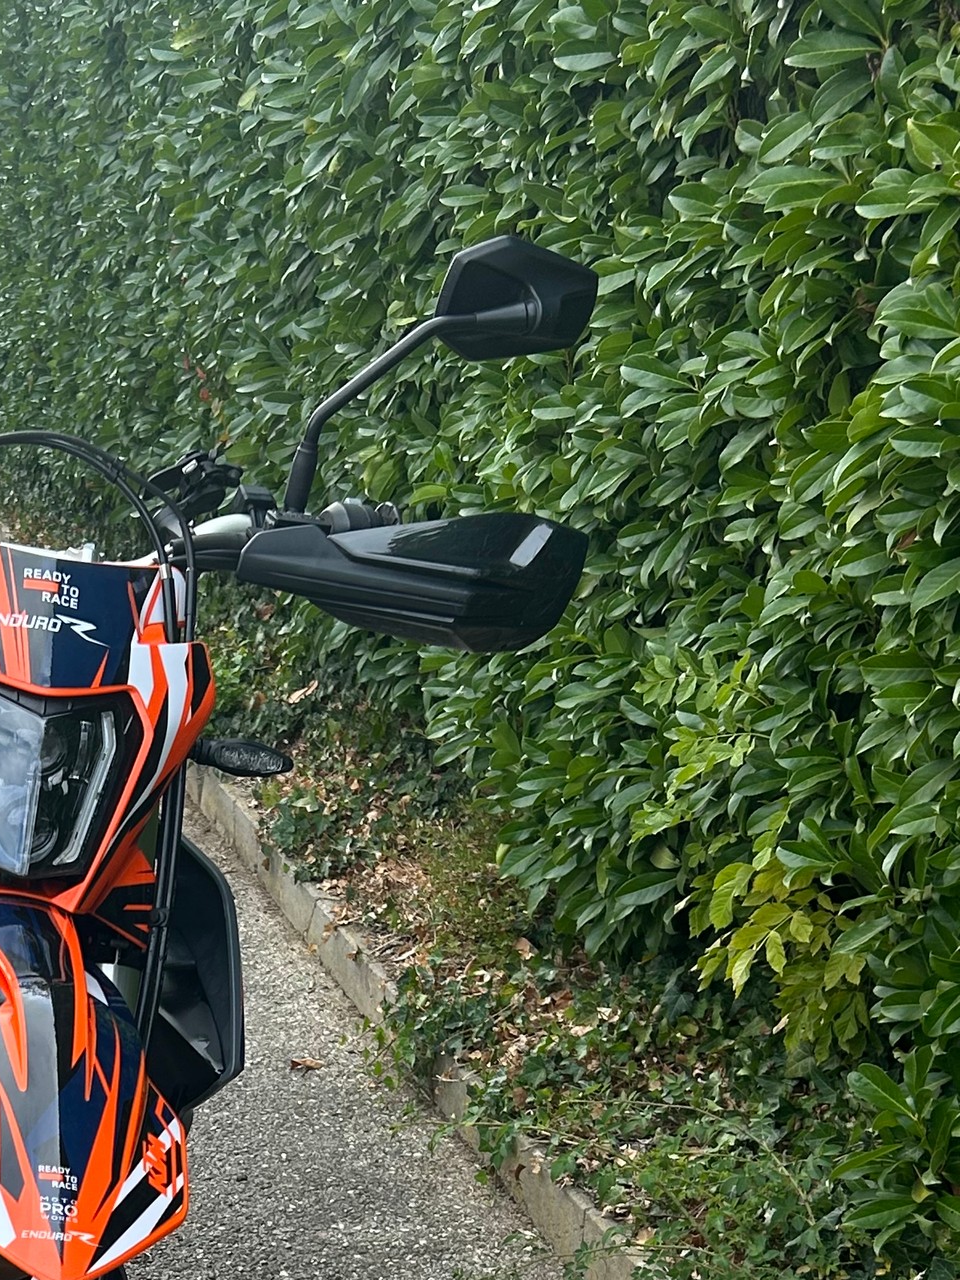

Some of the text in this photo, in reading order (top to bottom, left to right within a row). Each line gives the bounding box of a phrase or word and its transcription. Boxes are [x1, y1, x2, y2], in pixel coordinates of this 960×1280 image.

[23, 567, 71, 584] READY
[61, 584, 80, 598] TO
[41, 591, 79, 610] RACE
[37, 1164, 71, 1175] READY
[142, 1132, 168, 1197] KTM
[51, 1180, 78, 1191] RACE
[64, 1174, 78, 1184] TO
[40, 1195, 78, 1205] MOTO
[40, 1202, 78, 1217] PRO
[20, 1229, 73, 1242] ENDURO
